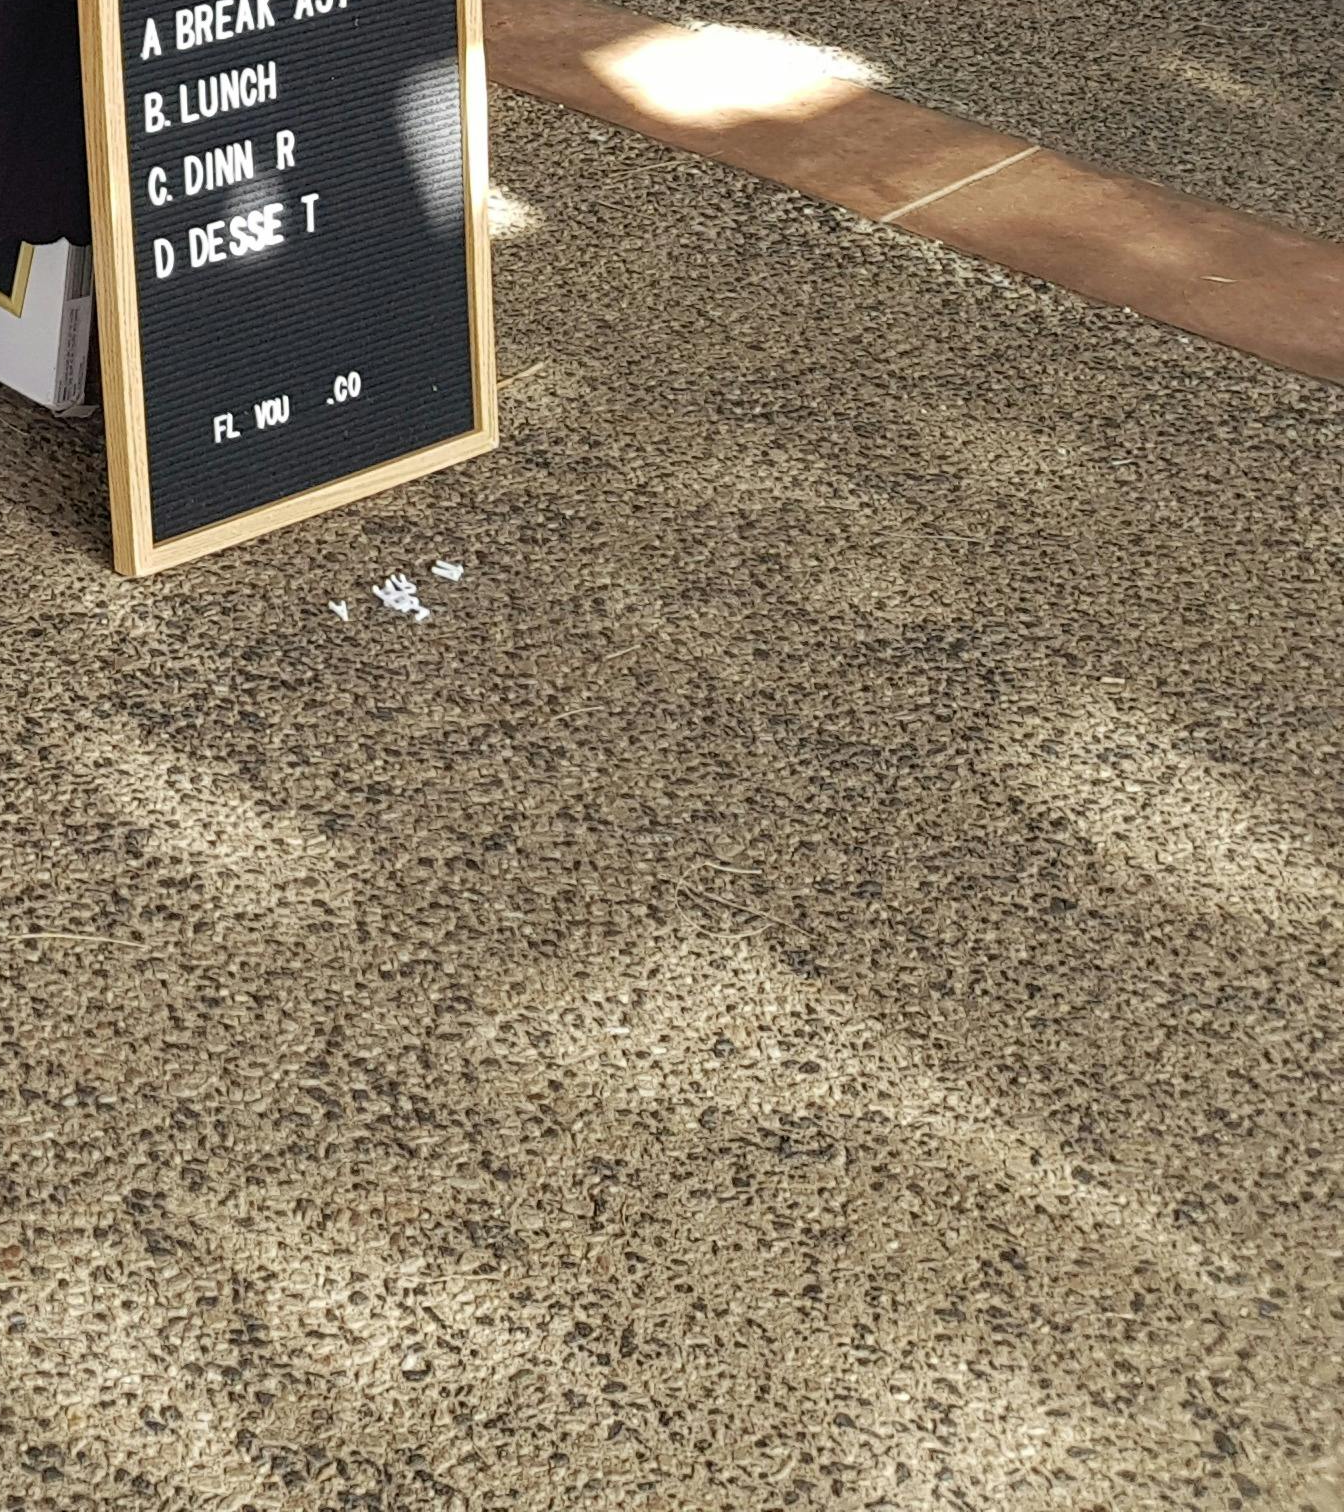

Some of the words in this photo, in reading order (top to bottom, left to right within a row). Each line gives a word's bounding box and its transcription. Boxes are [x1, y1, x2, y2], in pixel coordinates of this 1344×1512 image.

[141, 18, 161, 60] A
[145, 92, 171, 133] B.
[180, 61, 276, 123] LUNCH
[148, 167, 173, 205] C.
[184, 140, 254, 195] DINN
[277, 130, 295, 170] R
[154, 238, 174, 278] D
[189, 203, 284, 267] DESSE
[301, 194, 319, 232] T
[214, 413, 240, 443] FL
[255, 396, 289, 429] VOU
